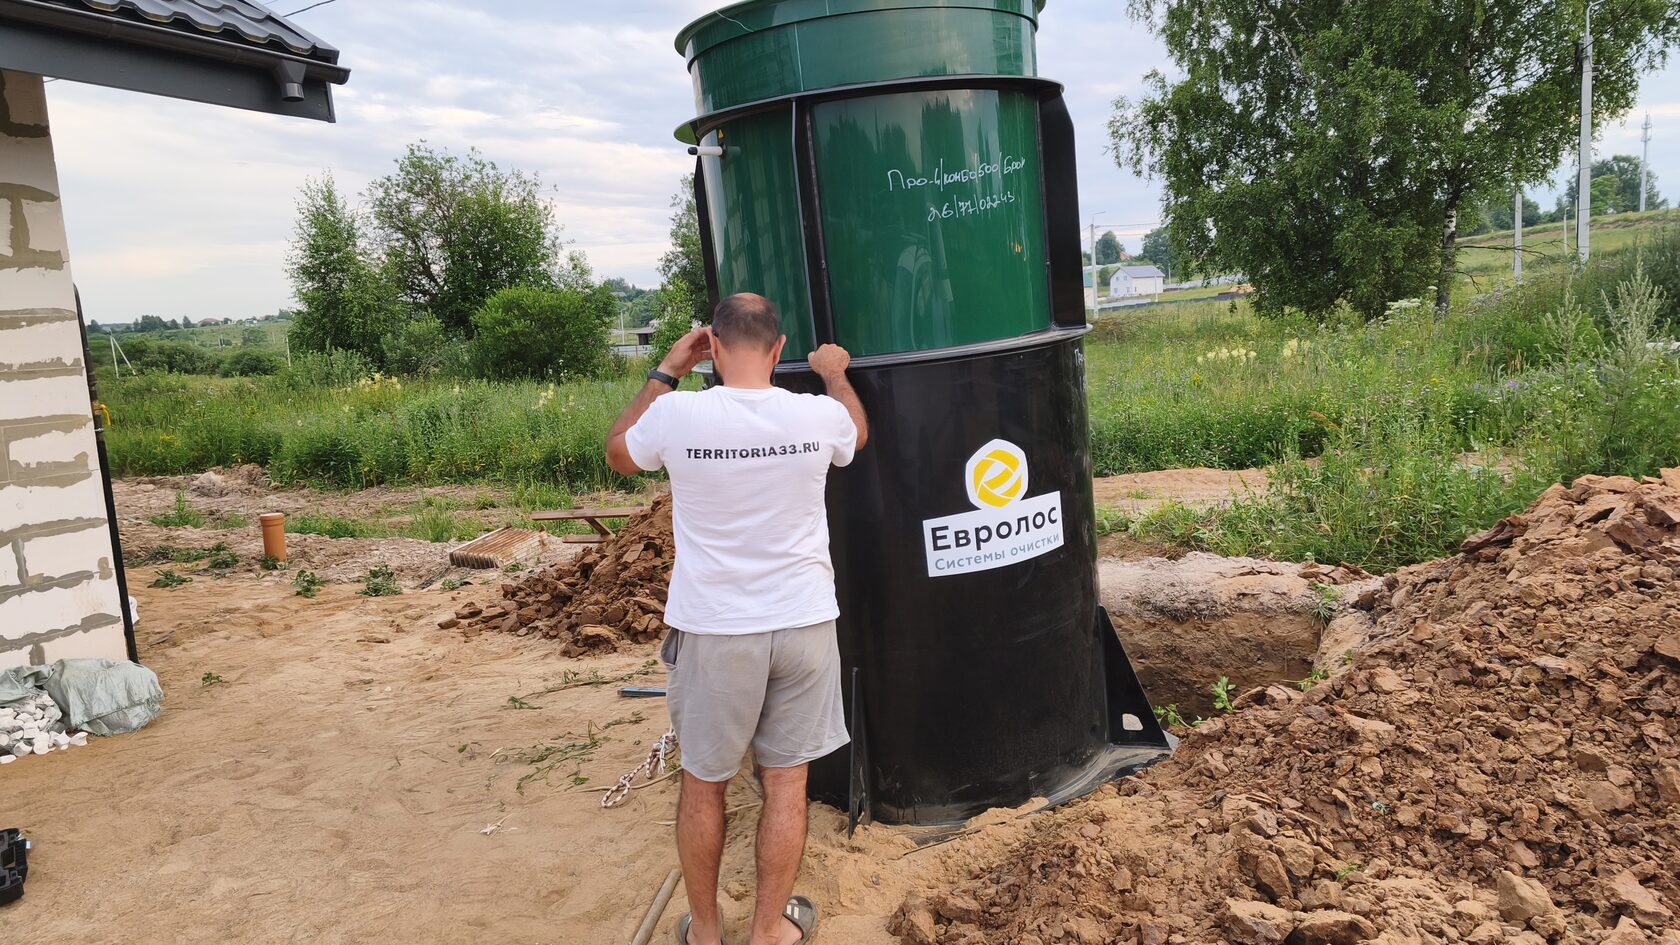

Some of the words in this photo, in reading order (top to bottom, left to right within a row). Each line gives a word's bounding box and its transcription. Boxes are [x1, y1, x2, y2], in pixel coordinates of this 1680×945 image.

[686, 441, 820, 459] TERRITORIA33.RU
[931, 506, 1058, 551] Евролос
[935, 551, 1006, 571] Системы
[1010, 533, 1060, 556] очистки
